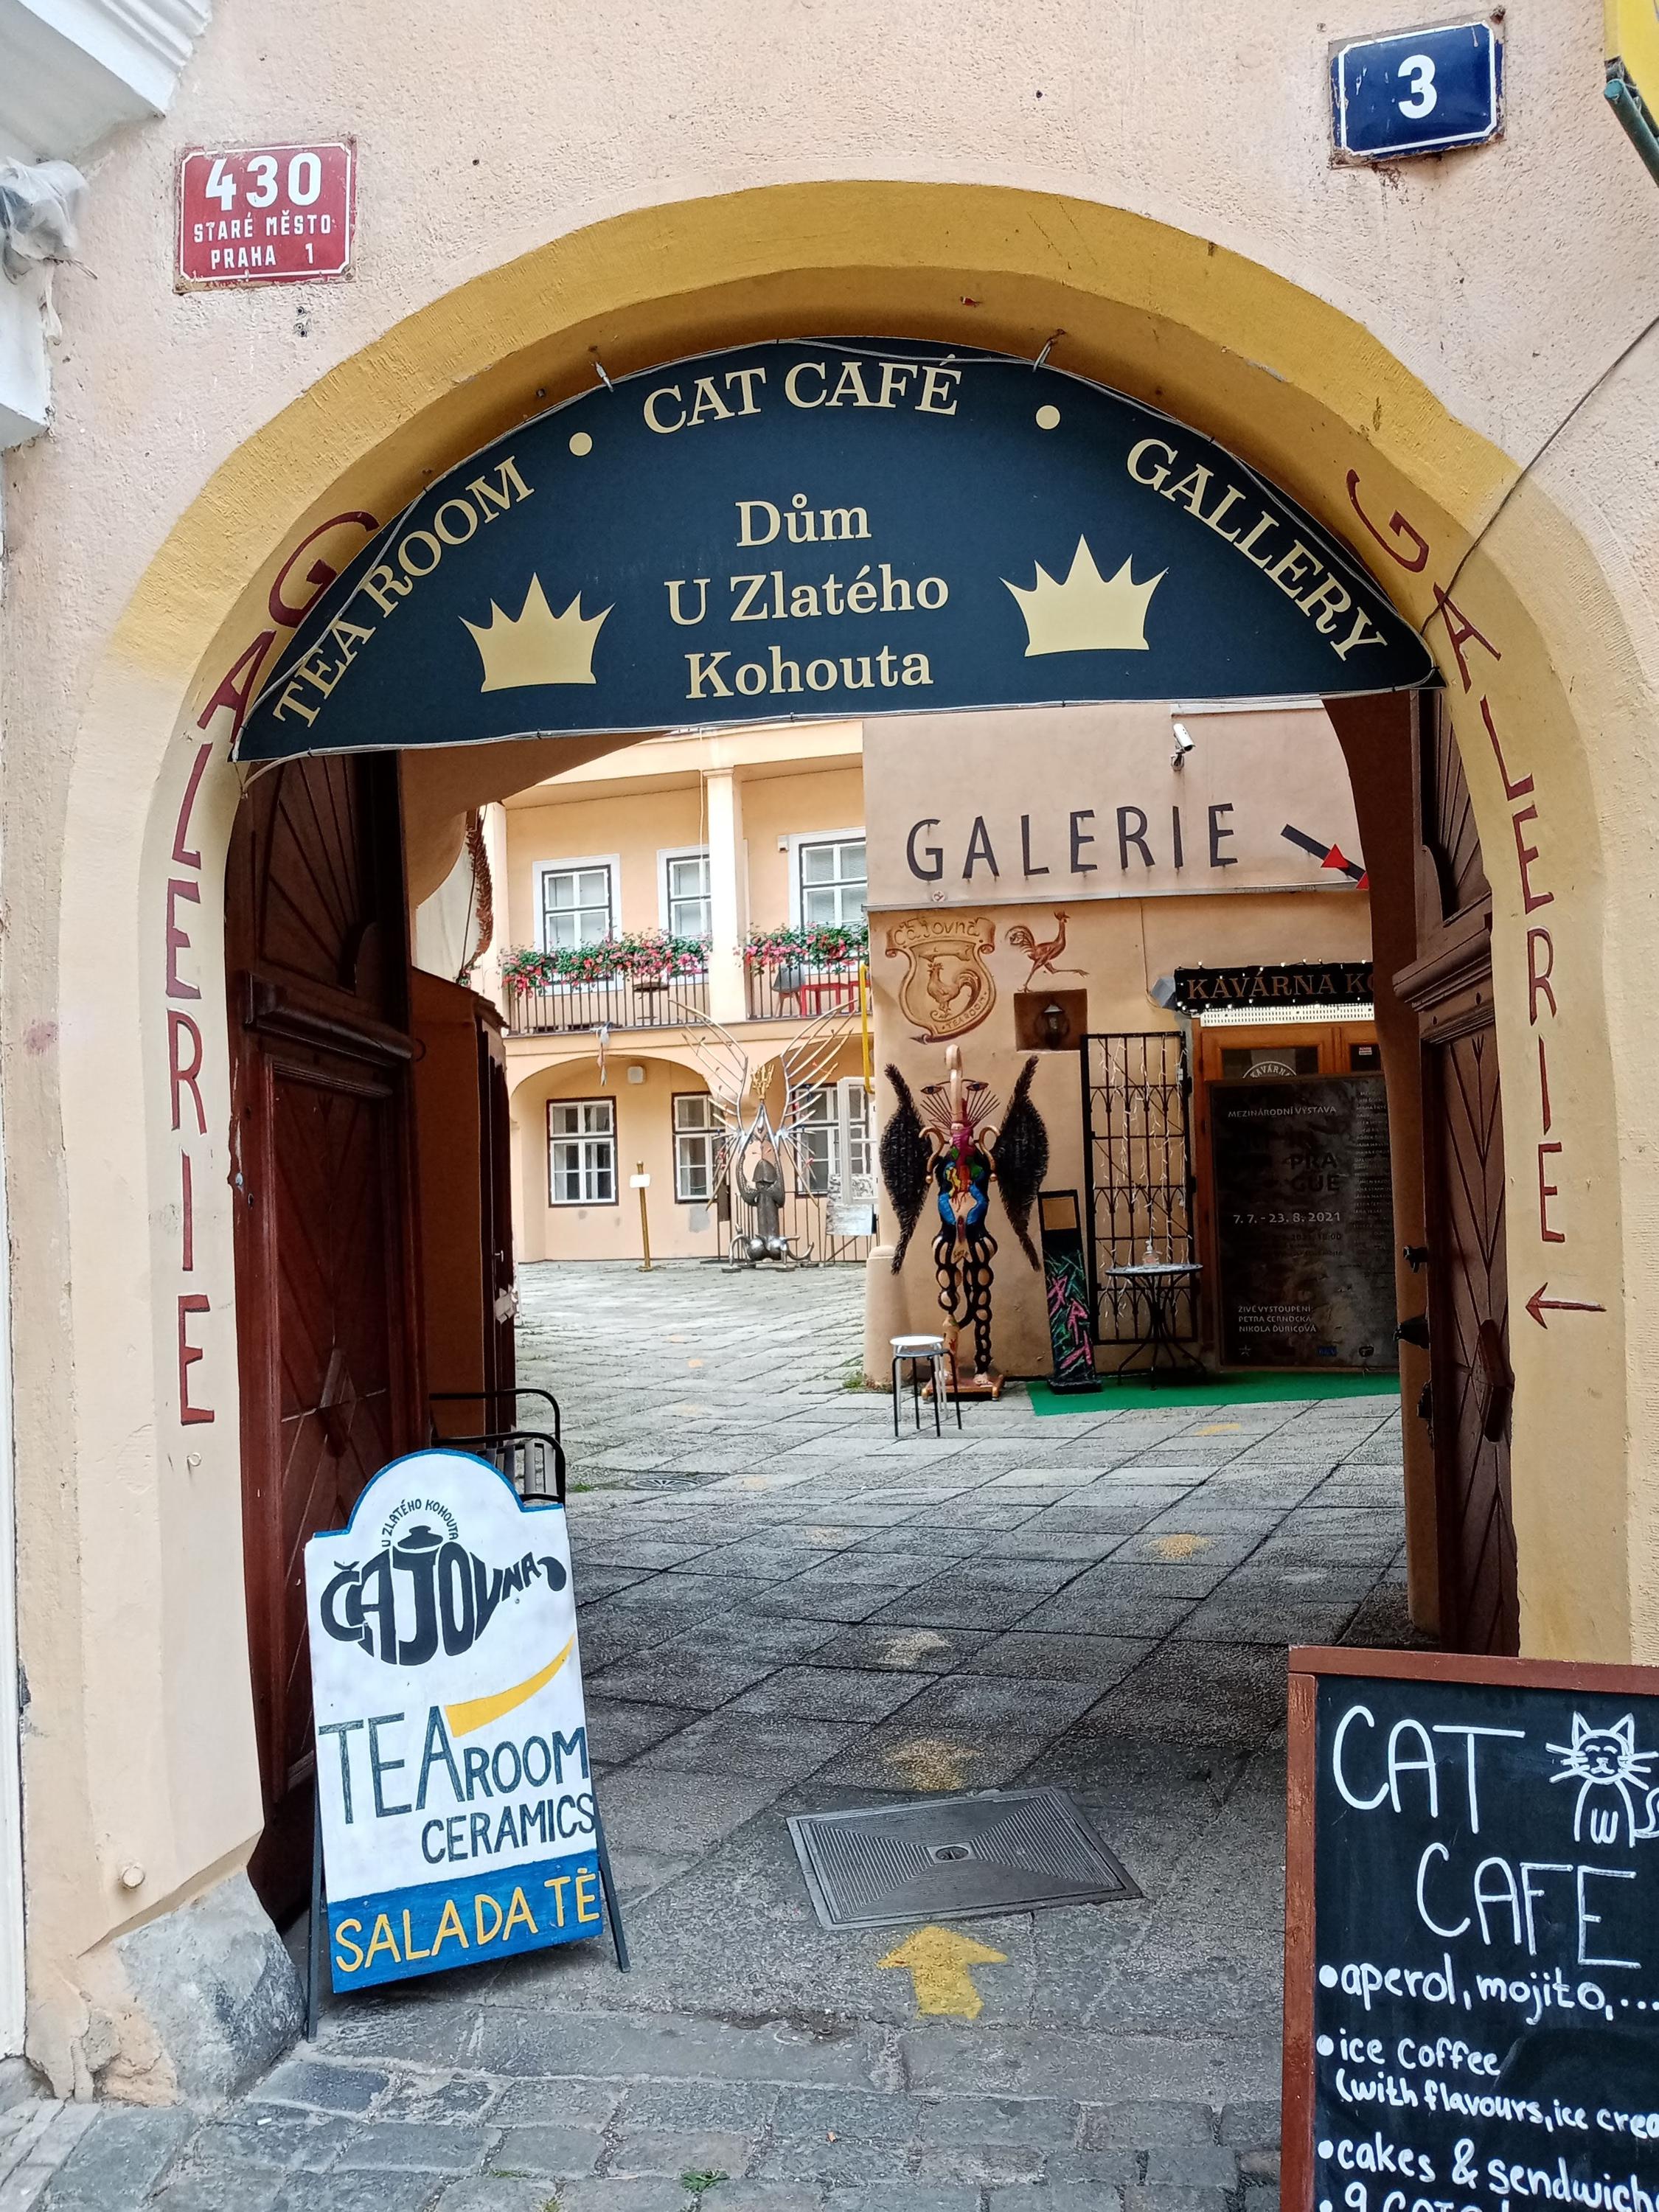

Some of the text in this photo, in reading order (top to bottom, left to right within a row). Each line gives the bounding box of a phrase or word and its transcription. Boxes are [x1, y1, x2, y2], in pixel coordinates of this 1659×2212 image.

[1397, 54, 1438, 119] 3
[205, 152, 322, 211] 430
[193, 209, 331, 243] STARÉ MĚSTO
[211, 243, 313, 270] PRAHA 1
[643, 354, 962, 434] CAT CAFÉ
[734, 493, 872, 546] Dům
[1126, 439, 1388, 662] GALLERY
[272, 455, 535, 728] TEA ROOM
[664, 563, 949, 625] U Zlatého
[684, 645, 933, 699] Kohouta
[906, 803, 1238, 881] GALERIE
[1346, 468, 1565, 1244] GALERIE
[165, 510, 380, 1427] GALERIE
[1187, 970, 1335, 1000] KAVÁRNA
[382, 1499, 422, 1537] ZLATÉHO
[425, 1499, 459, 1540] KOHOUTA
[320, 1542, 542, 1666] ČAJOVNA
[1333, 1705, 1526, 1834] CAT
[421, 1792, 596, 1864] CERAMICS
[335, 1886, 538, 1972] SALADA
[1416, 1843, 1641, 1969] CAFE
[1339, 2028, 1385, 2065] ice
[1337, 2132, 1436, 2183] cakes
[1452, 2138, 1478, 2189] &
[1487, 2157, 1659, 2212] sendwich
